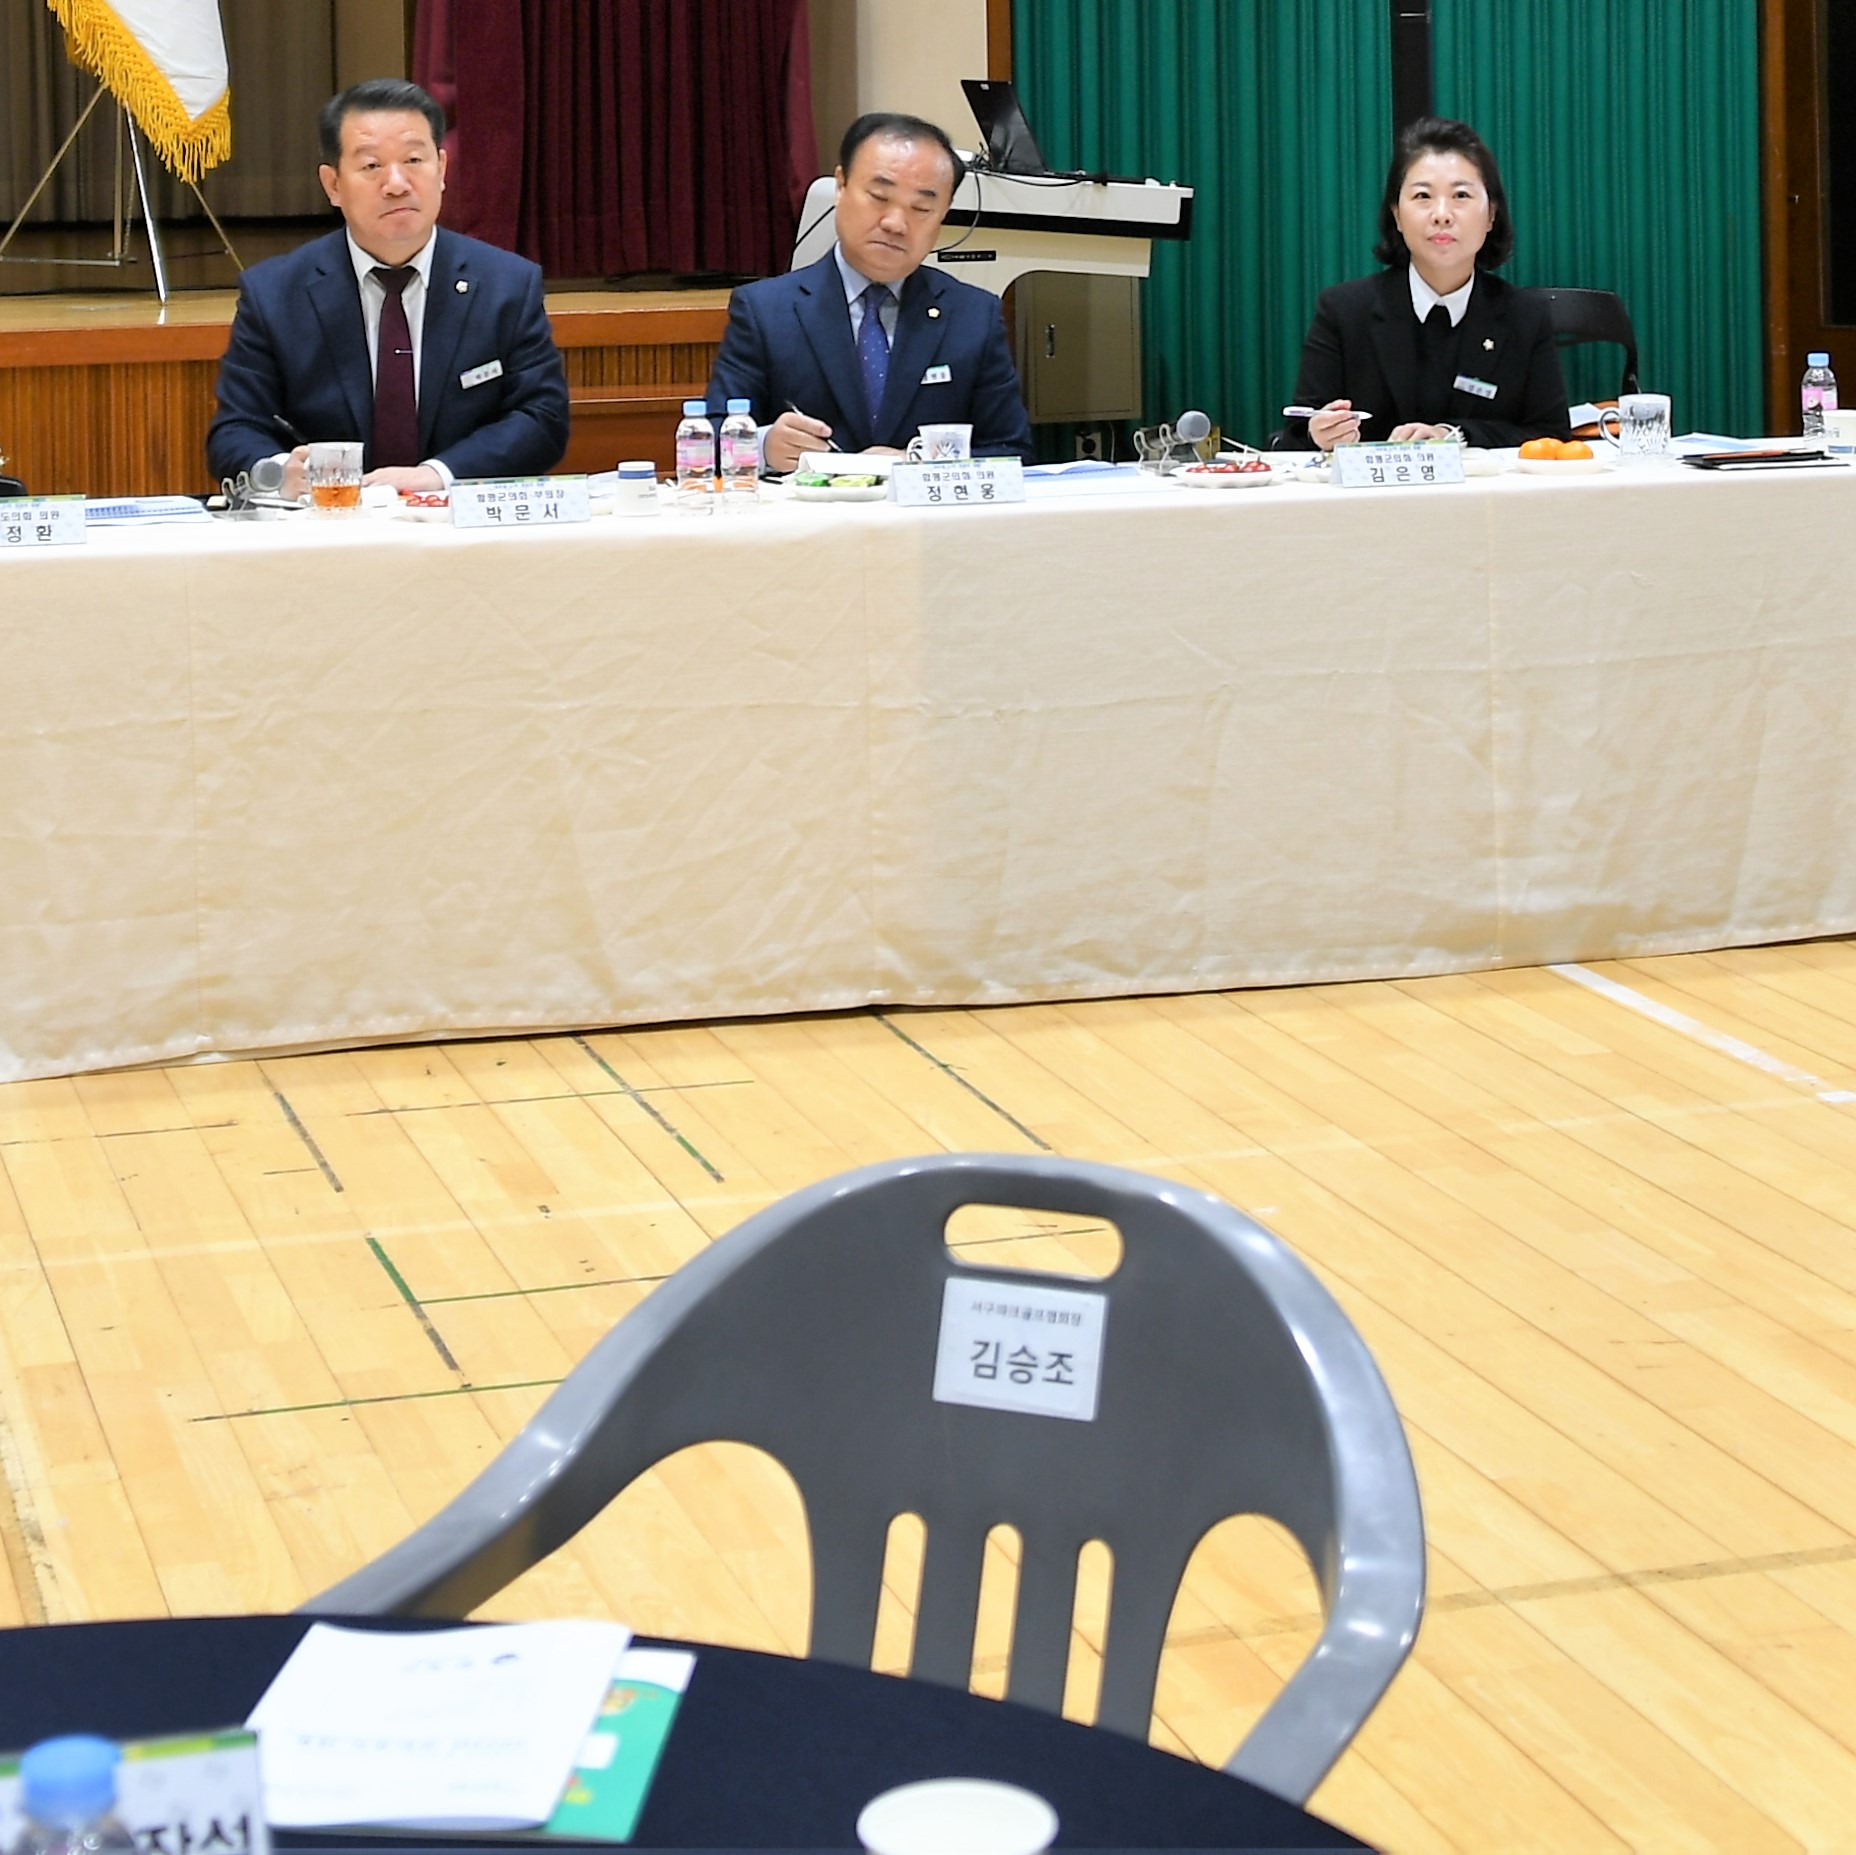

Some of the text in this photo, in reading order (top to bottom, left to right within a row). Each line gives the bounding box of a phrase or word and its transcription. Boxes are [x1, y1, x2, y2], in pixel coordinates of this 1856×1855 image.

[1369, 465, 1436, 483] 김은영
[927, 483, 995, 502] 정현웅
[486, 503, 559, 522] 박문서
[969, 1339, 1075, 1386] 김승조
